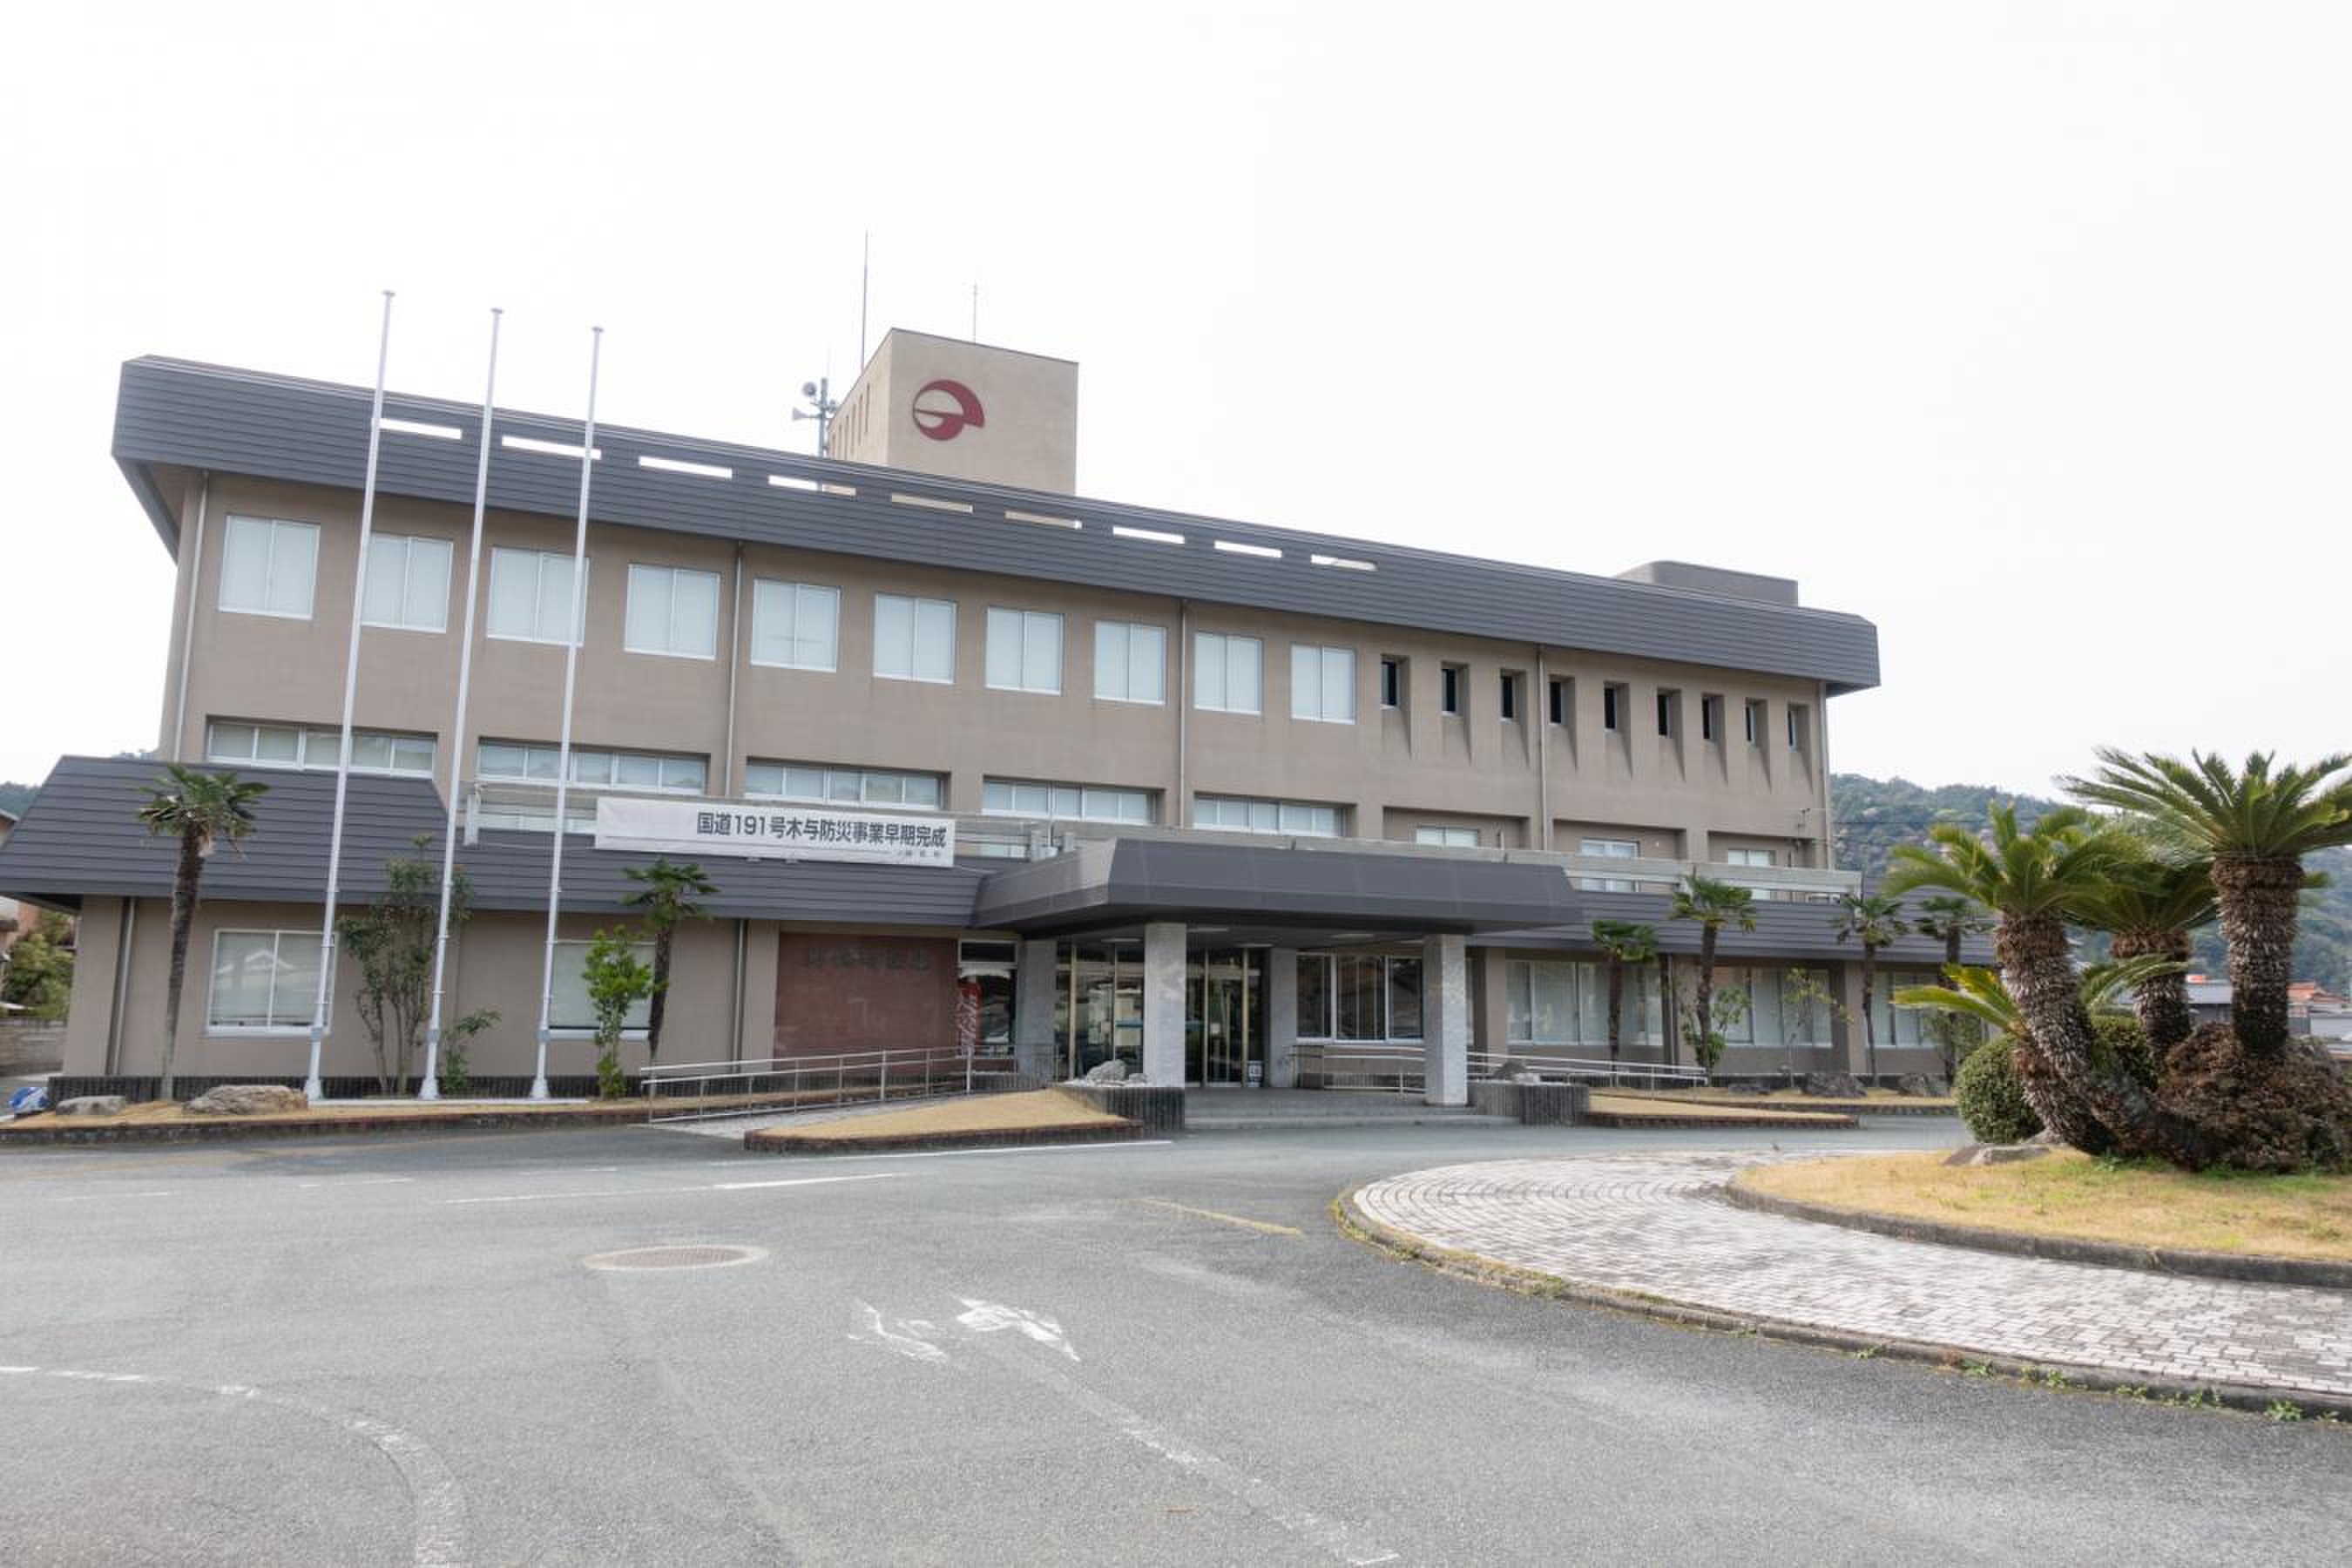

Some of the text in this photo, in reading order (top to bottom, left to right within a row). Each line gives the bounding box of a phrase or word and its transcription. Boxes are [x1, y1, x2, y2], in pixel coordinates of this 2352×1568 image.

[697, 812, 947, 848] 国道191号木与防災事業早期完成
